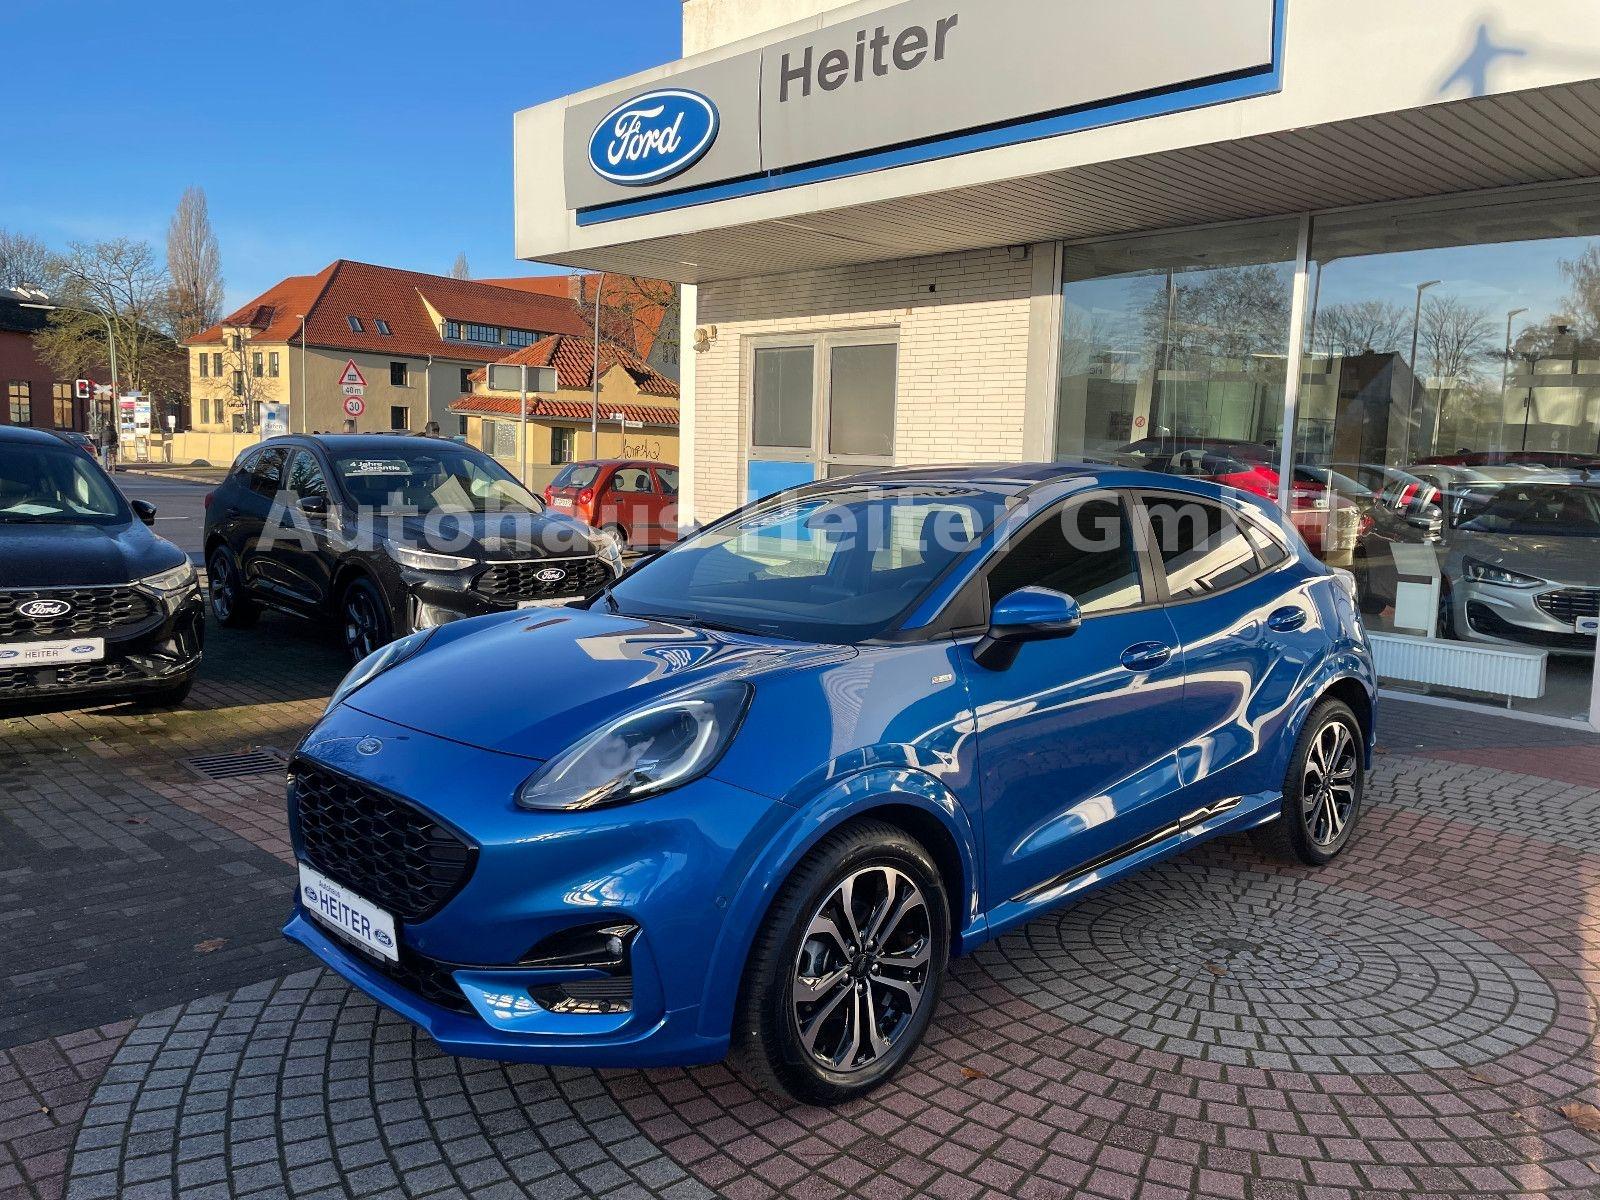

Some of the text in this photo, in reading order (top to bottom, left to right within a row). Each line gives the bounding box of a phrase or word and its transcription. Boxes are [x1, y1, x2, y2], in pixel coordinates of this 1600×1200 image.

[779, 14, 958, 102] Heiter
[607, 105, 684, 165] Ford
[349, 402, 360, 411] 30
[542, 570, 560, 580] Ford
[29, 602, 62, 615] Ford
[25, 650, 59, 659] HEITER
[320, 889, 371, 941] HEITER
